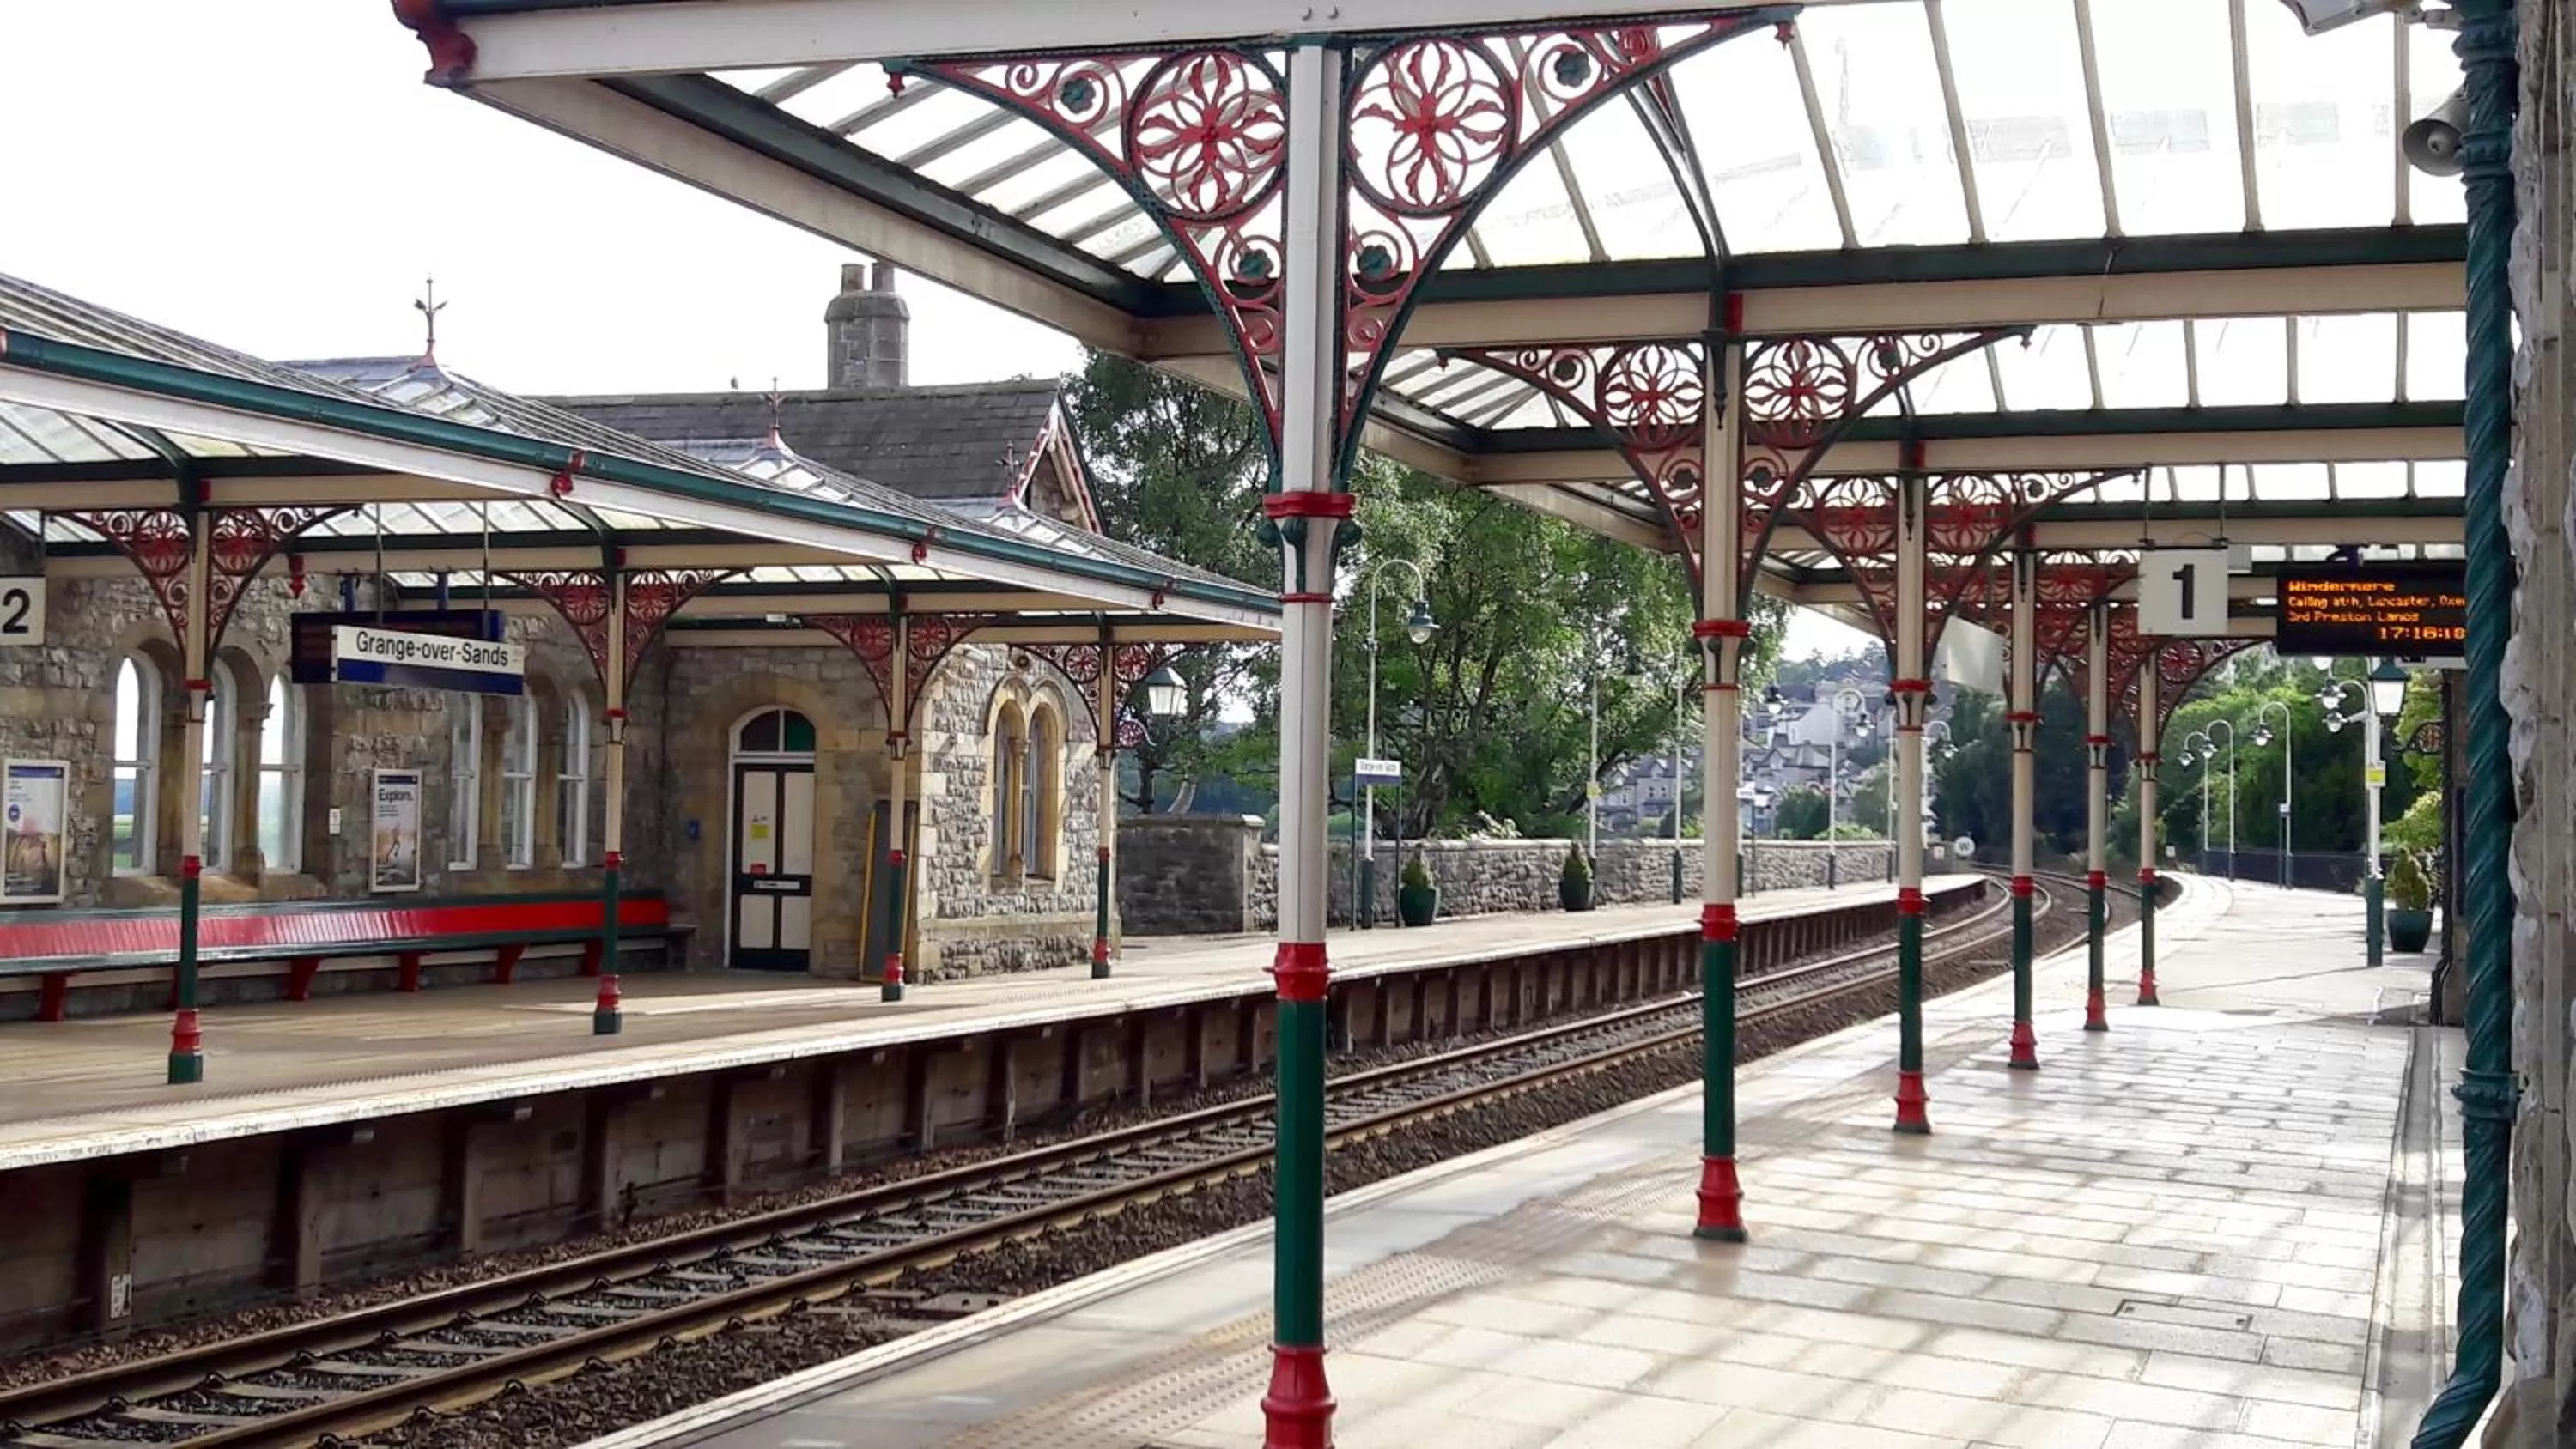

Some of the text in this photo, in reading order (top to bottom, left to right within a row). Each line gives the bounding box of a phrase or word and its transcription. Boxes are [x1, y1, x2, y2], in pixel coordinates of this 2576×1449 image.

[2172, 563, 2194, 619] 1
[2288, 580, 2395, 591] Windermere
[2, 588, 30, 634] 2
[2288, 596, 2328, 609] Calling
[2287, 610, 2311, 622] 3rd
[2314, 610, 2372, 622] Preston
[356, 631, 508, 667] Grange-over-Sands
